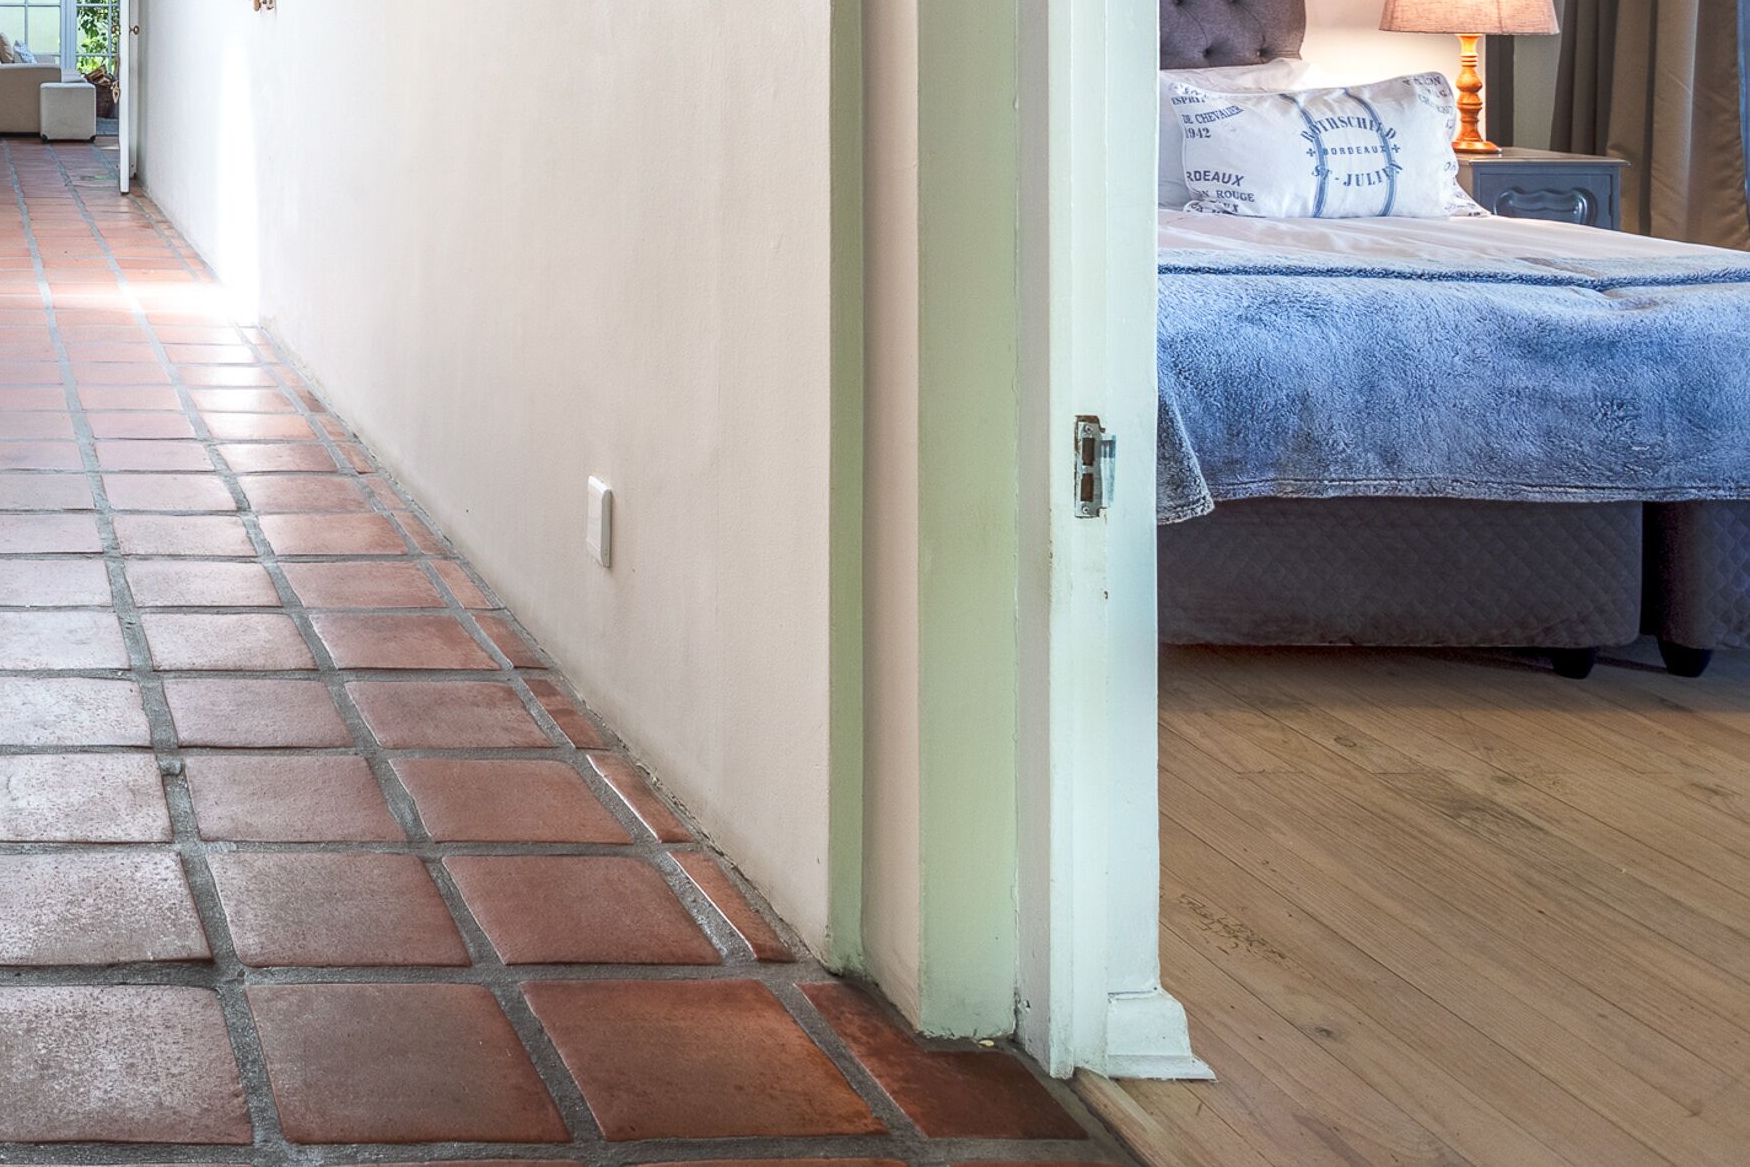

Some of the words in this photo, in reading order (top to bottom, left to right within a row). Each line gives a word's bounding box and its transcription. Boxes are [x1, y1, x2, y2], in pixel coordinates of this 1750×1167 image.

[1194, 104, 1244, 125] CHEVALIER
[1185, 127, 1211, 139] 1942
[1323, 145, 1387, 156] BORDEAUX
[1216, 190, 1255, 203] ROUGE
